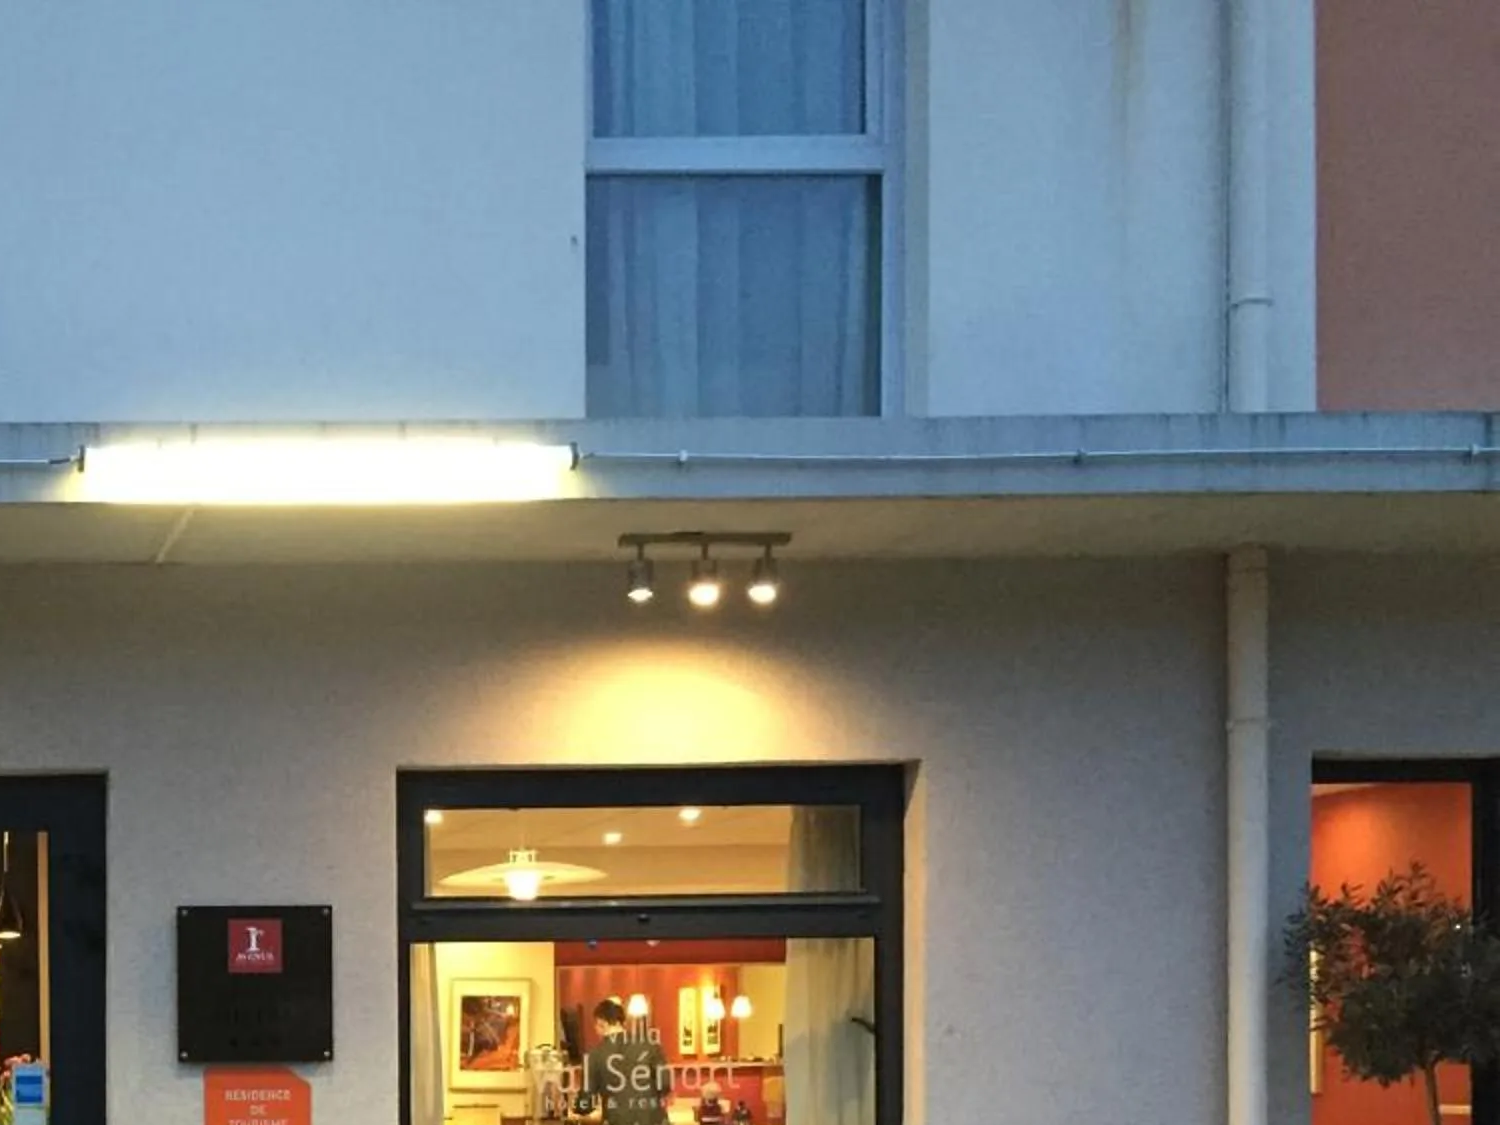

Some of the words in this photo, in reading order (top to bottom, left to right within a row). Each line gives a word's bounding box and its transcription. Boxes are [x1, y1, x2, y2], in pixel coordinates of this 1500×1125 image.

[607, 1016, 661, 1045] Villa
[606, 1050, 741, 1092] Sénart
[249, 1105, 267, 1116] DE
